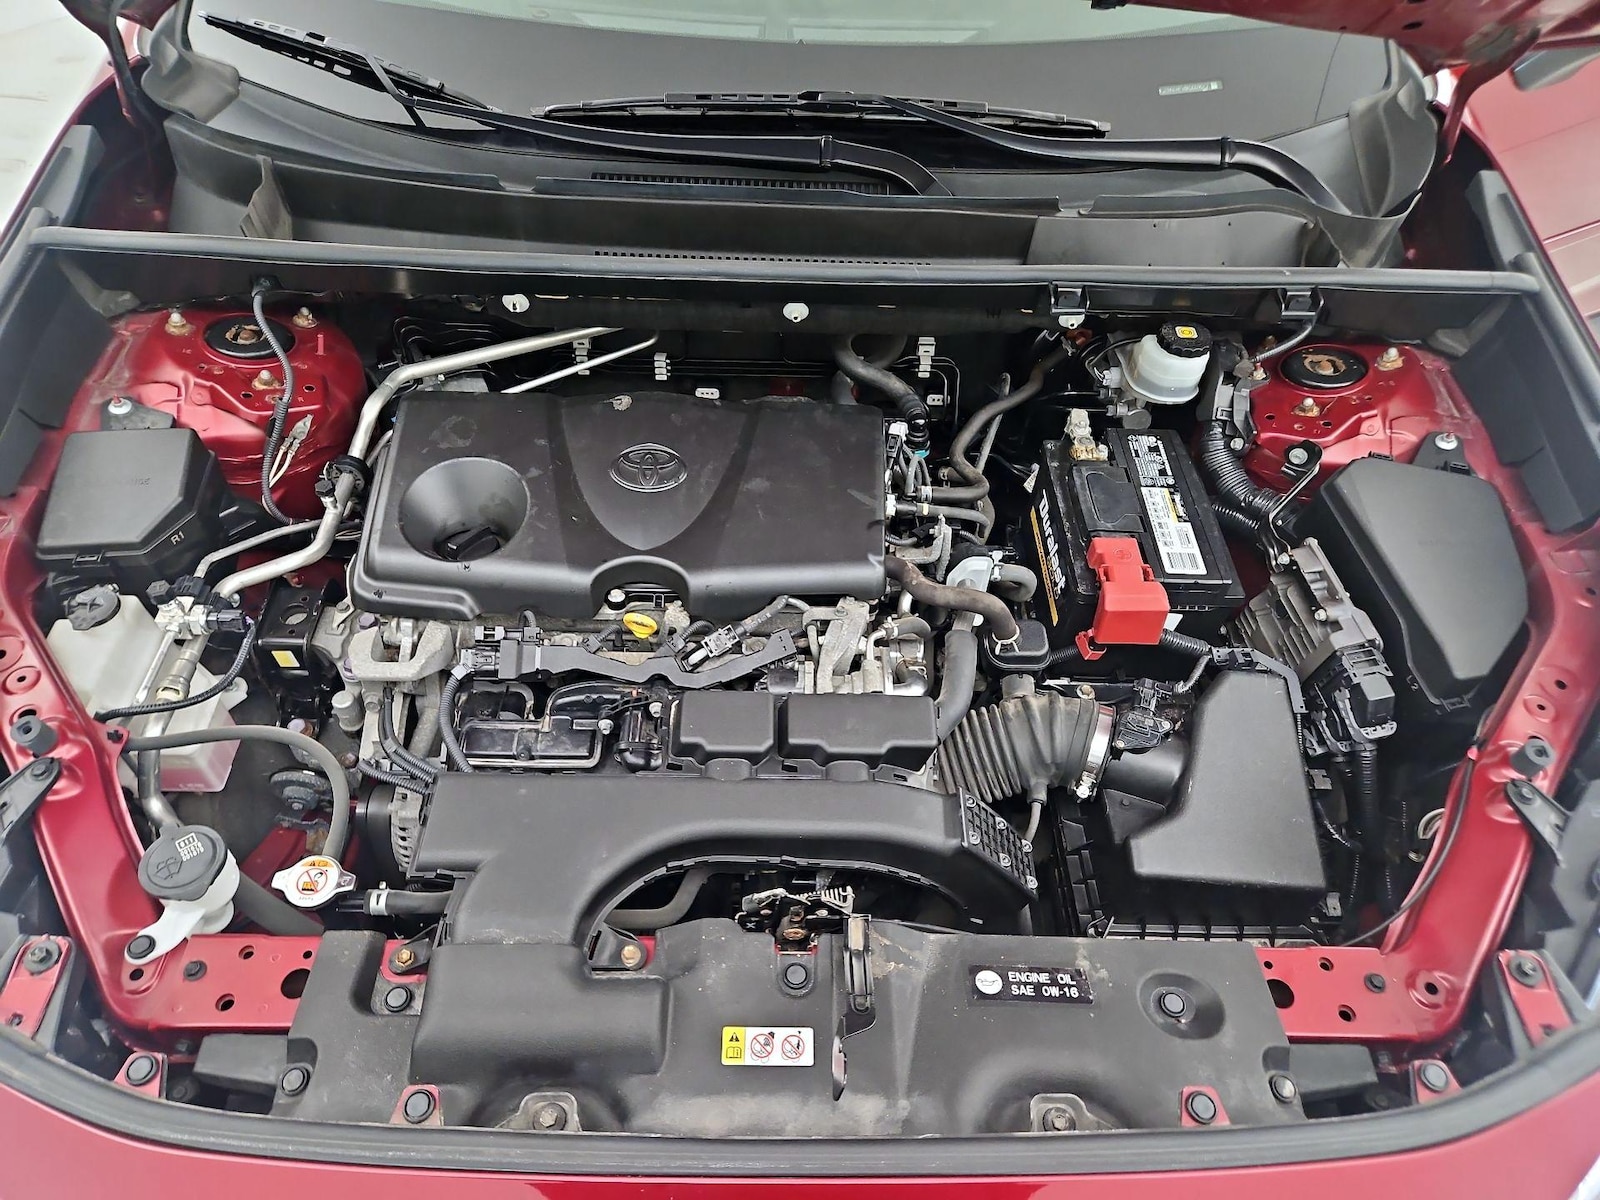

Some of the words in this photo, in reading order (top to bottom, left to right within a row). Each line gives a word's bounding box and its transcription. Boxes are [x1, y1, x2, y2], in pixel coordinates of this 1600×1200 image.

[171, 531, 185, 545] R1
[1039, 489, 1067, 596] Duralast
[1008, 971, 1051, 984] ENGINE
[1057, 974, 1077, 985] OIL
[1011, 985, 1036, 996] SAE
[1042, 986, 1079, 999] 0W-16
